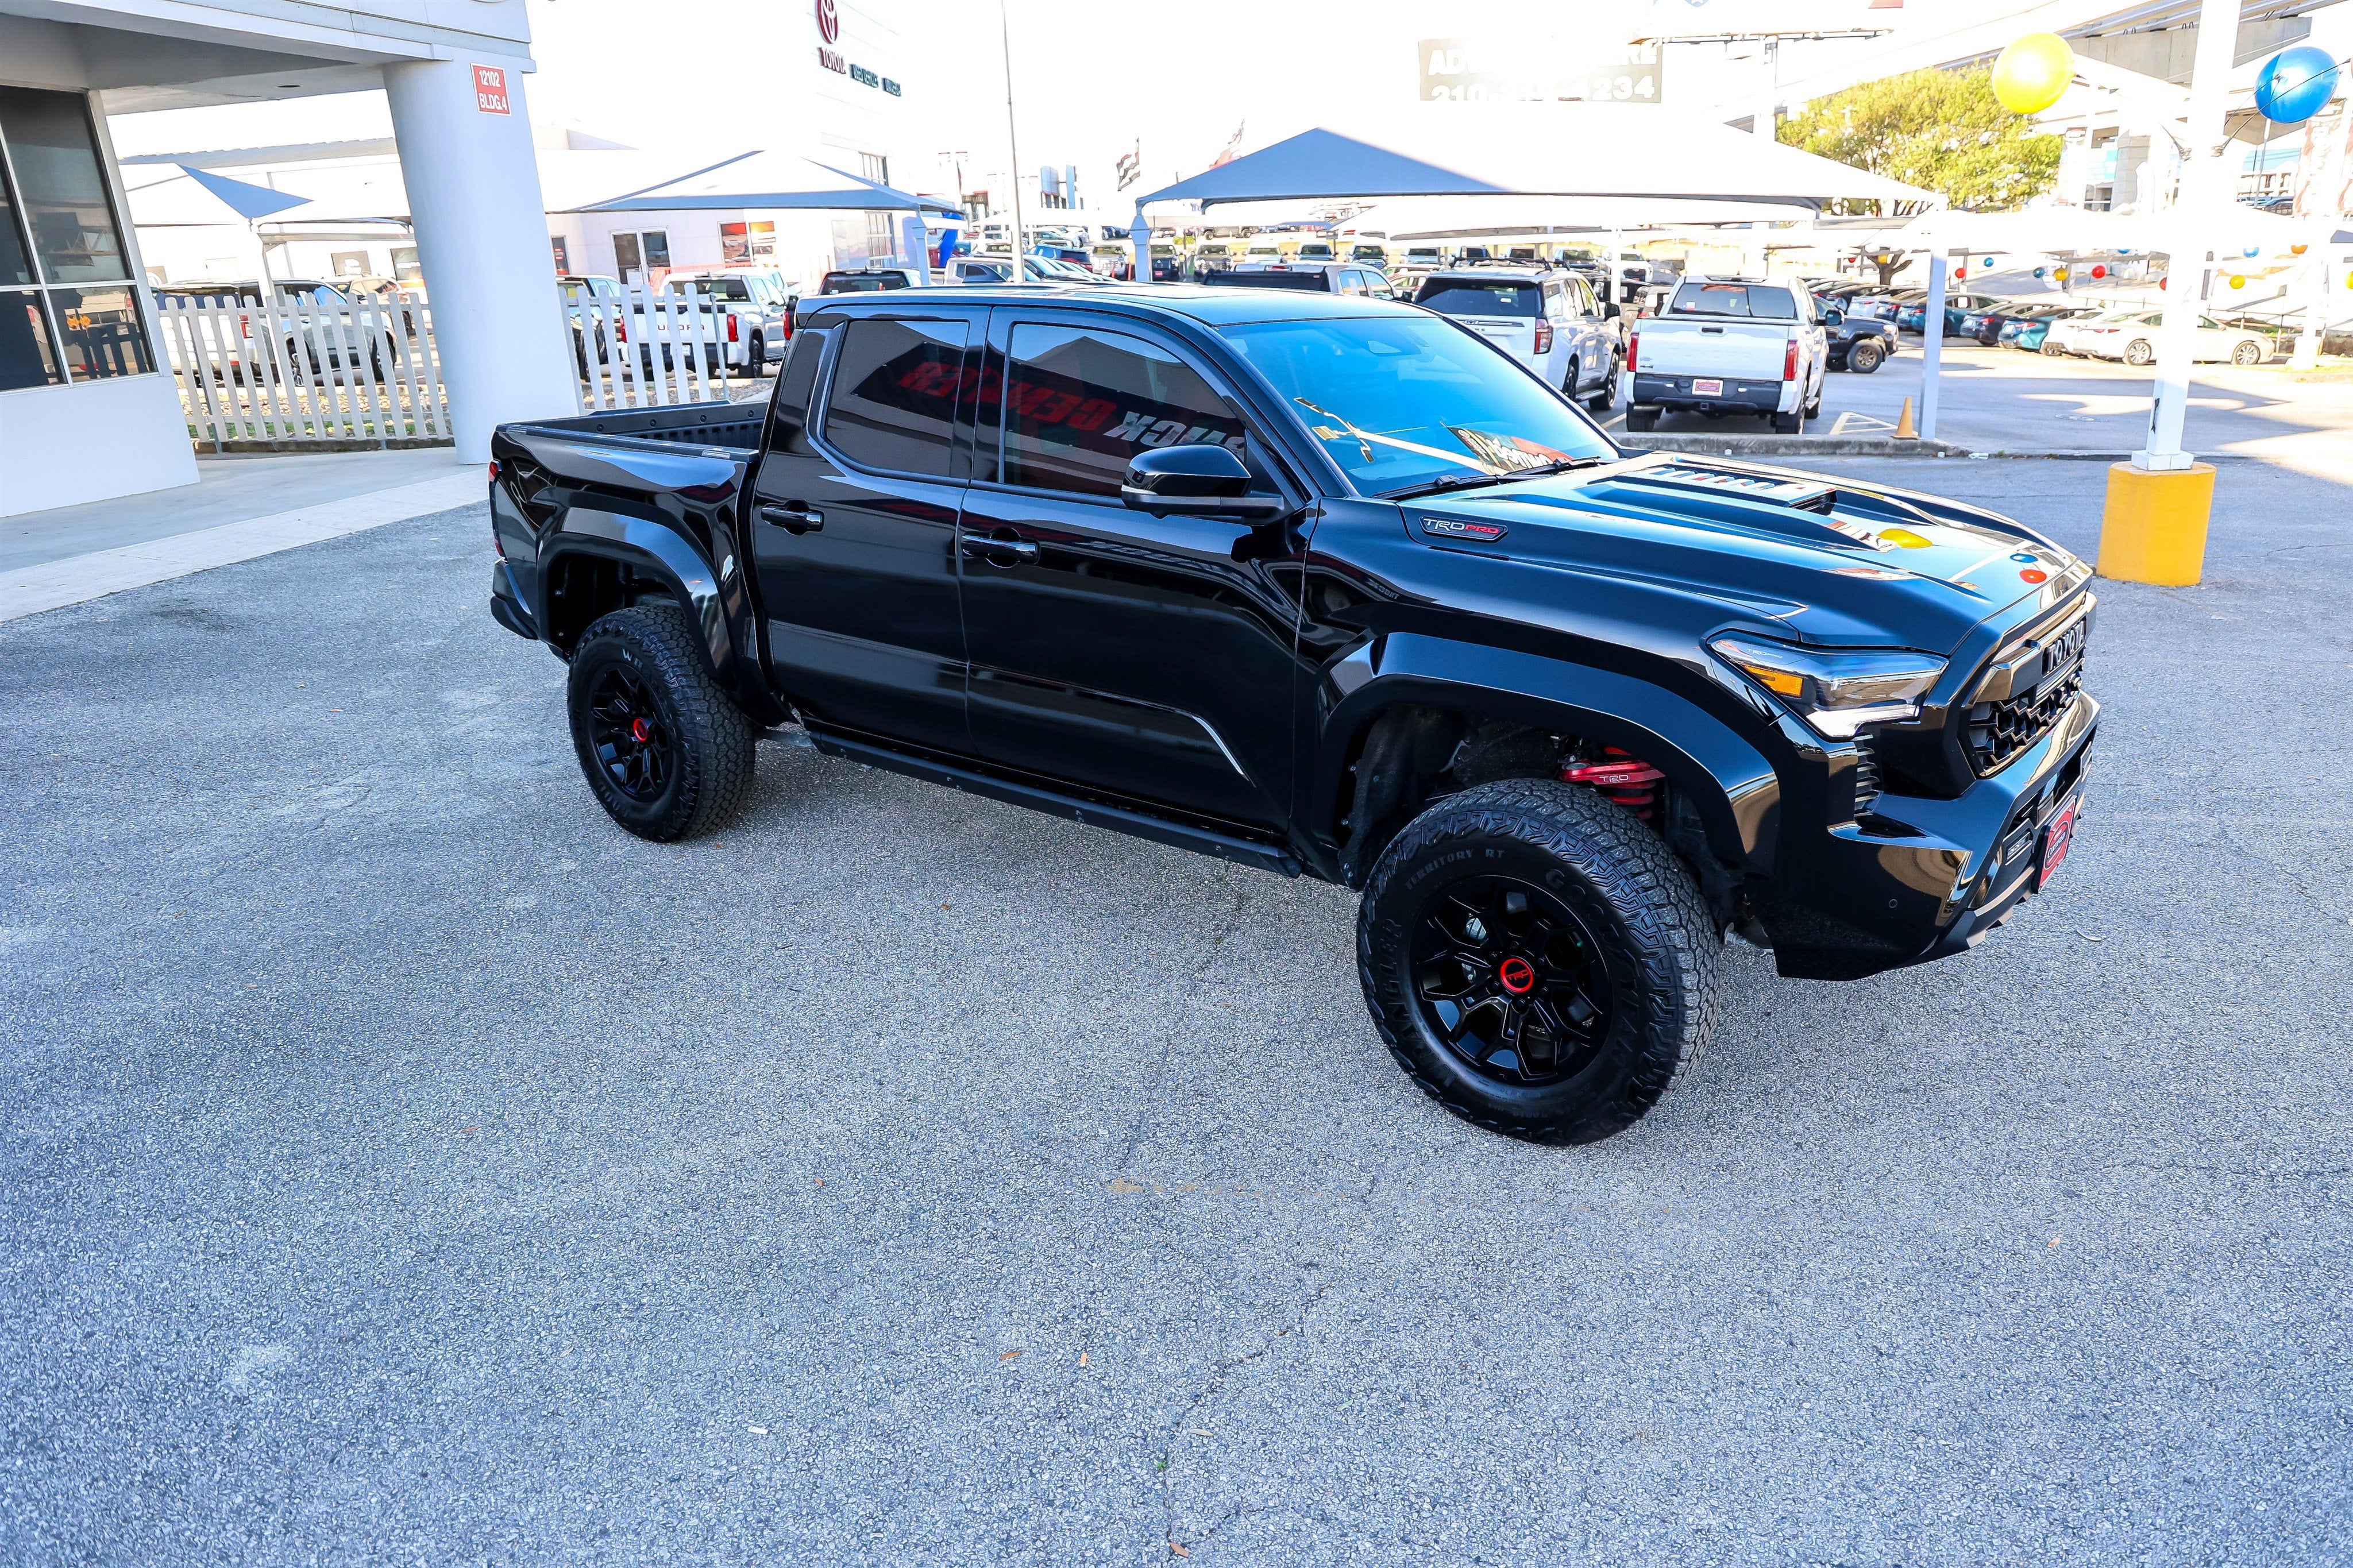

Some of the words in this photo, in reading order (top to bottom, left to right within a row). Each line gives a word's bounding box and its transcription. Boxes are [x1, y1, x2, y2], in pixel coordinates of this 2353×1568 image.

[479, 68, 502, 87] 12102
[501, 95, 508, 111] 4
[1423, 518, 1465, 532] TRD
[1465, 524, 1500, 535] PRO
[2046, 620, 2084, 674] TOYOTA
[1599, 774, 1629, 783] TRD
[1405, 848, 1474, 890] TERRITORY
[1485, 848, 1505, 858] RT
[1505, 968, 1529, 980] TRD
[1378, 918, 1459, 1088] WRANGLER
